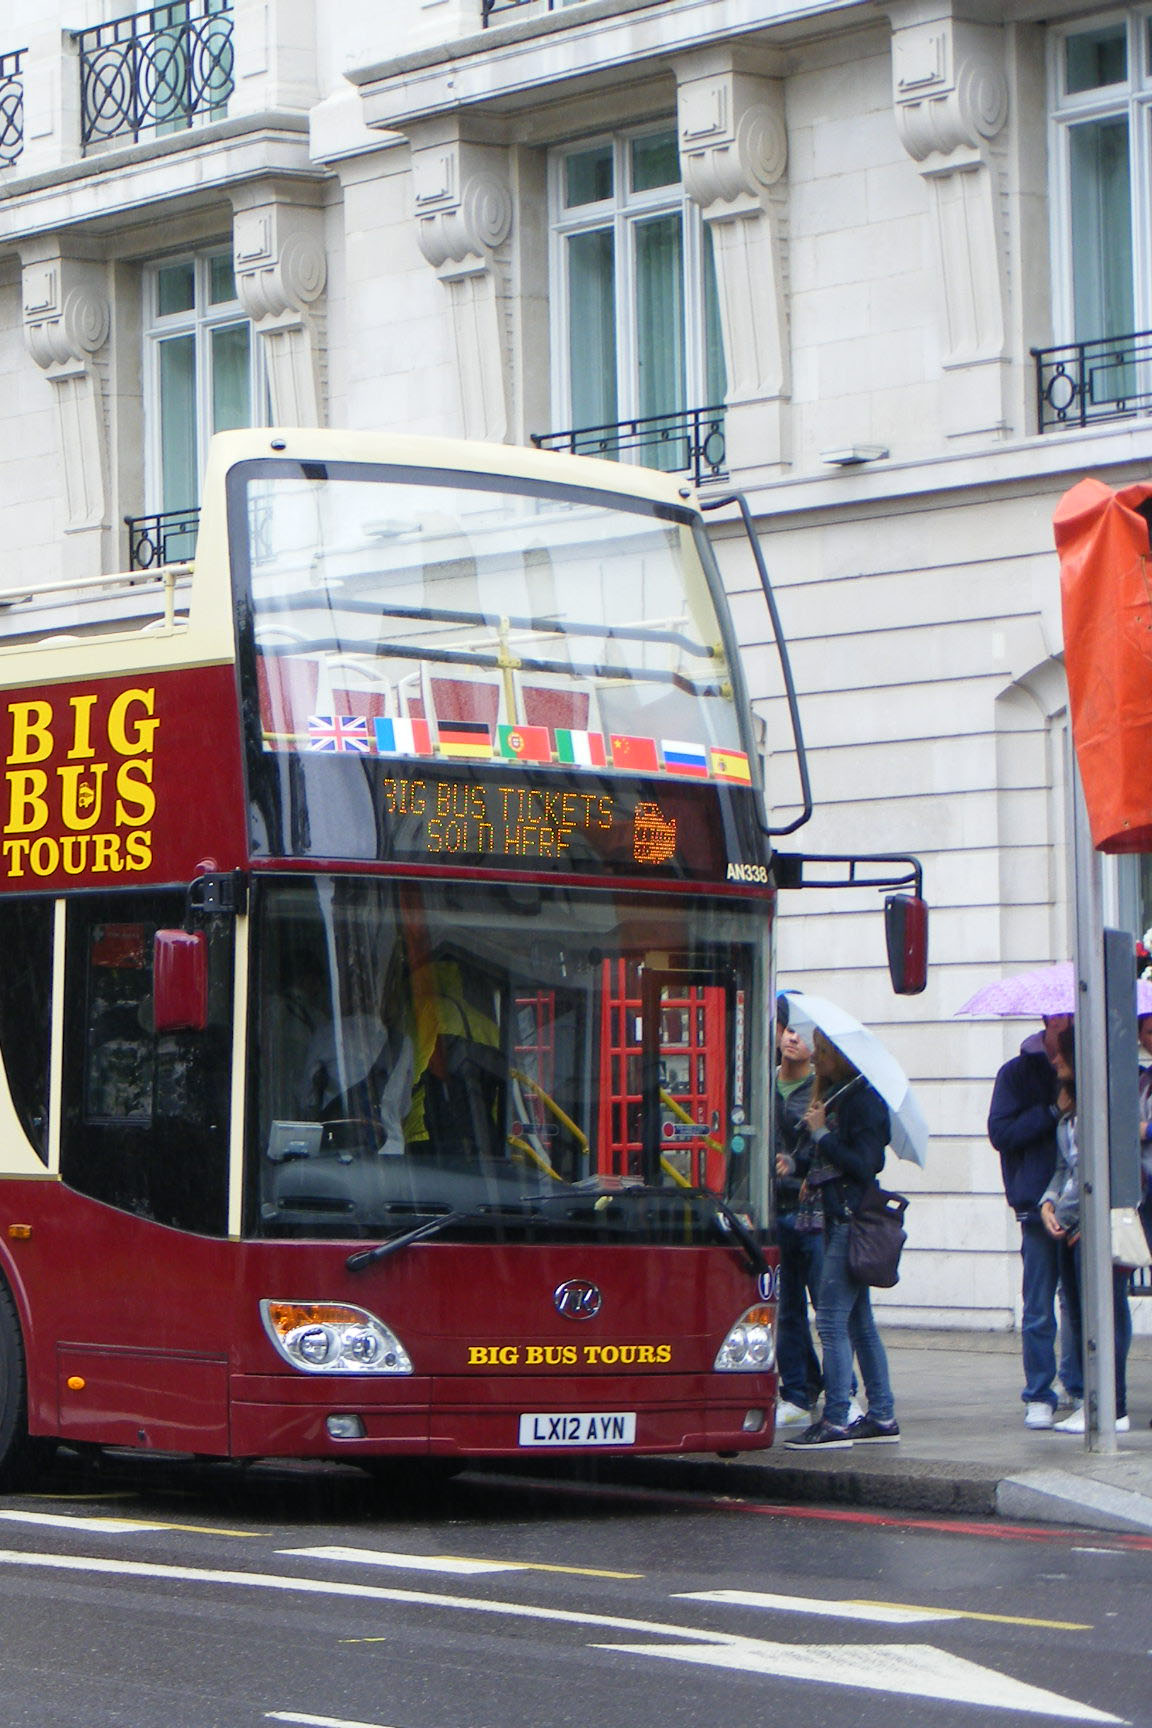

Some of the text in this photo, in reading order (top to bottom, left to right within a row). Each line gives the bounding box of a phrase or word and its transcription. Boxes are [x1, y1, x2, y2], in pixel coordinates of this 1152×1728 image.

[6, 688, 160, 765] BIG
[3, 759, 156, 834] BUS
[437, 782, 487, 819] BUS
[498, 787, 614, 829] TICKETS
[3, 831, 153, 878] TOURS
[726, 863, 768, 883] AN338
[467, 1344, 672, 1365] BIG BUS TOURS
[533, 1416, 625, 1440] LX12 AYN
